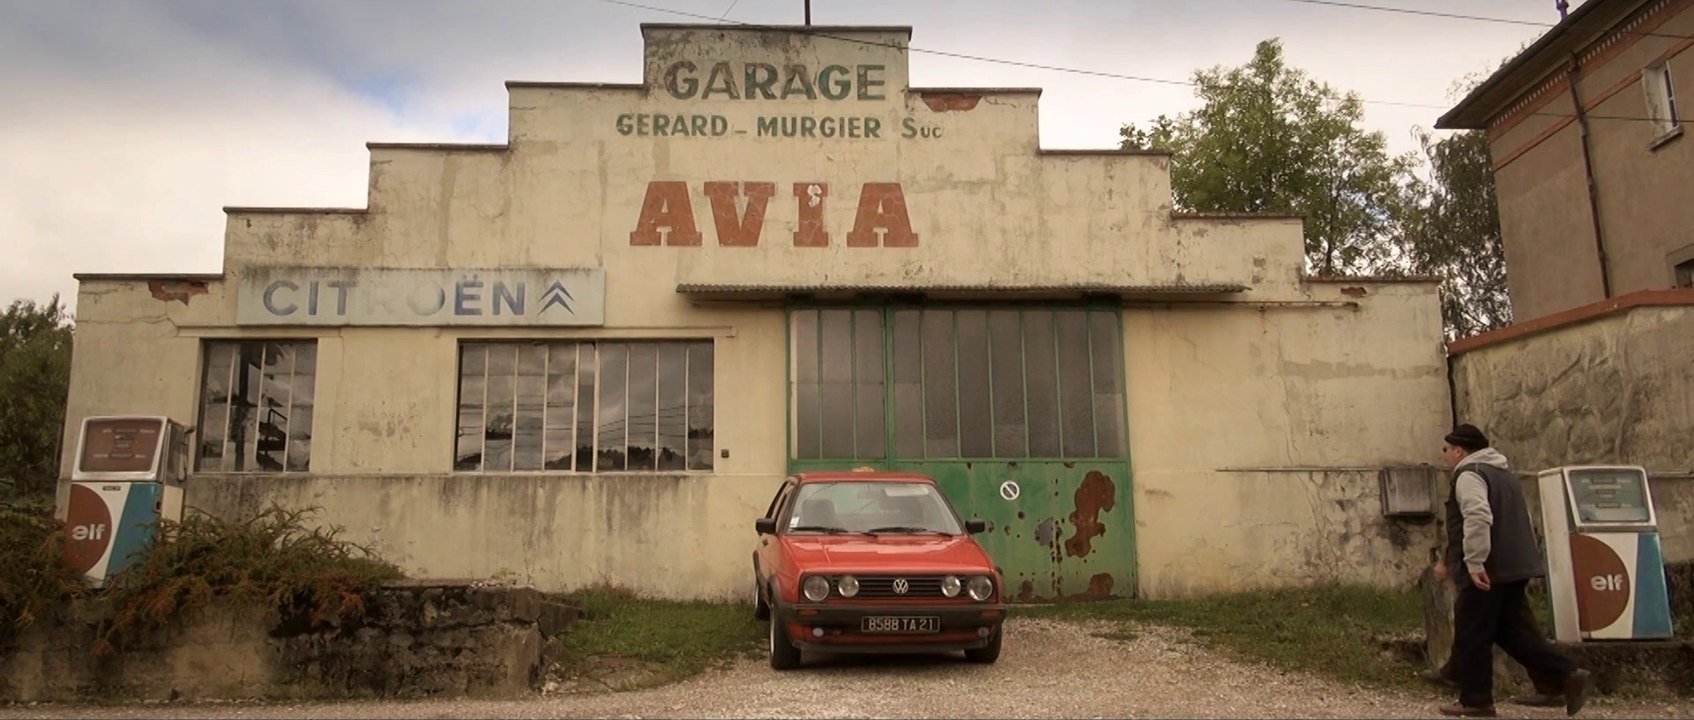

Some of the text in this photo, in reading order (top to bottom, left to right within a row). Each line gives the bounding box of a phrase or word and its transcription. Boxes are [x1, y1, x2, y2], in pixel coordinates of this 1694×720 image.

[663, 60, 886, 101] GARAGE
[615, 112, 728, 137] GERARD
[757, 116, 881, 139] MURGIER
[629, 180, 919, 248] AVIA
[71, 523, 106, 541] elf
[1590, 574, 1623, 591] elf
[868, 619, 933, 631] 8588 TA 21
